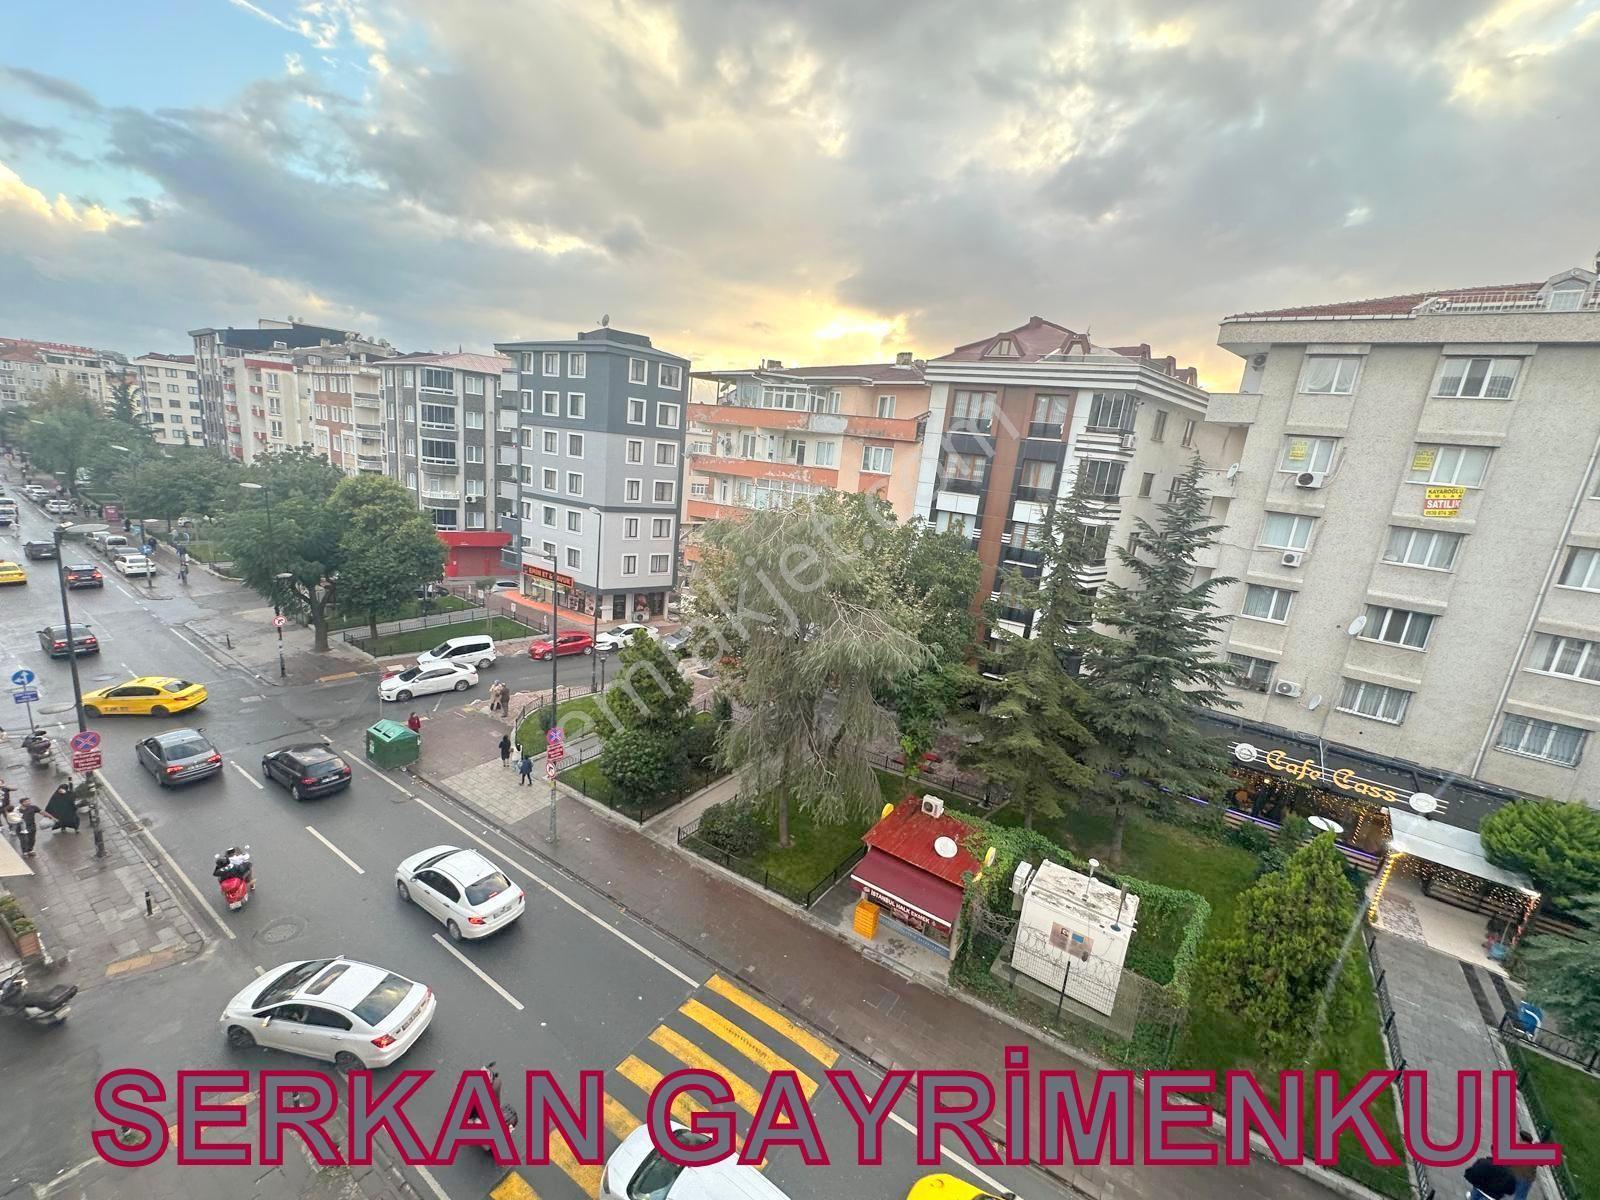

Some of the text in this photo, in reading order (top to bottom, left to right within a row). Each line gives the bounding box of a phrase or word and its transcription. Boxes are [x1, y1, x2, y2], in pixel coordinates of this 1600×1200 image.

[1426, 499, 1461, 508] SATILIK
[1266, 749, 1398, 802] Cafe Cass
[896, 903, 910, 915] HALK
[910, 910, 930, 924] EKMEK
